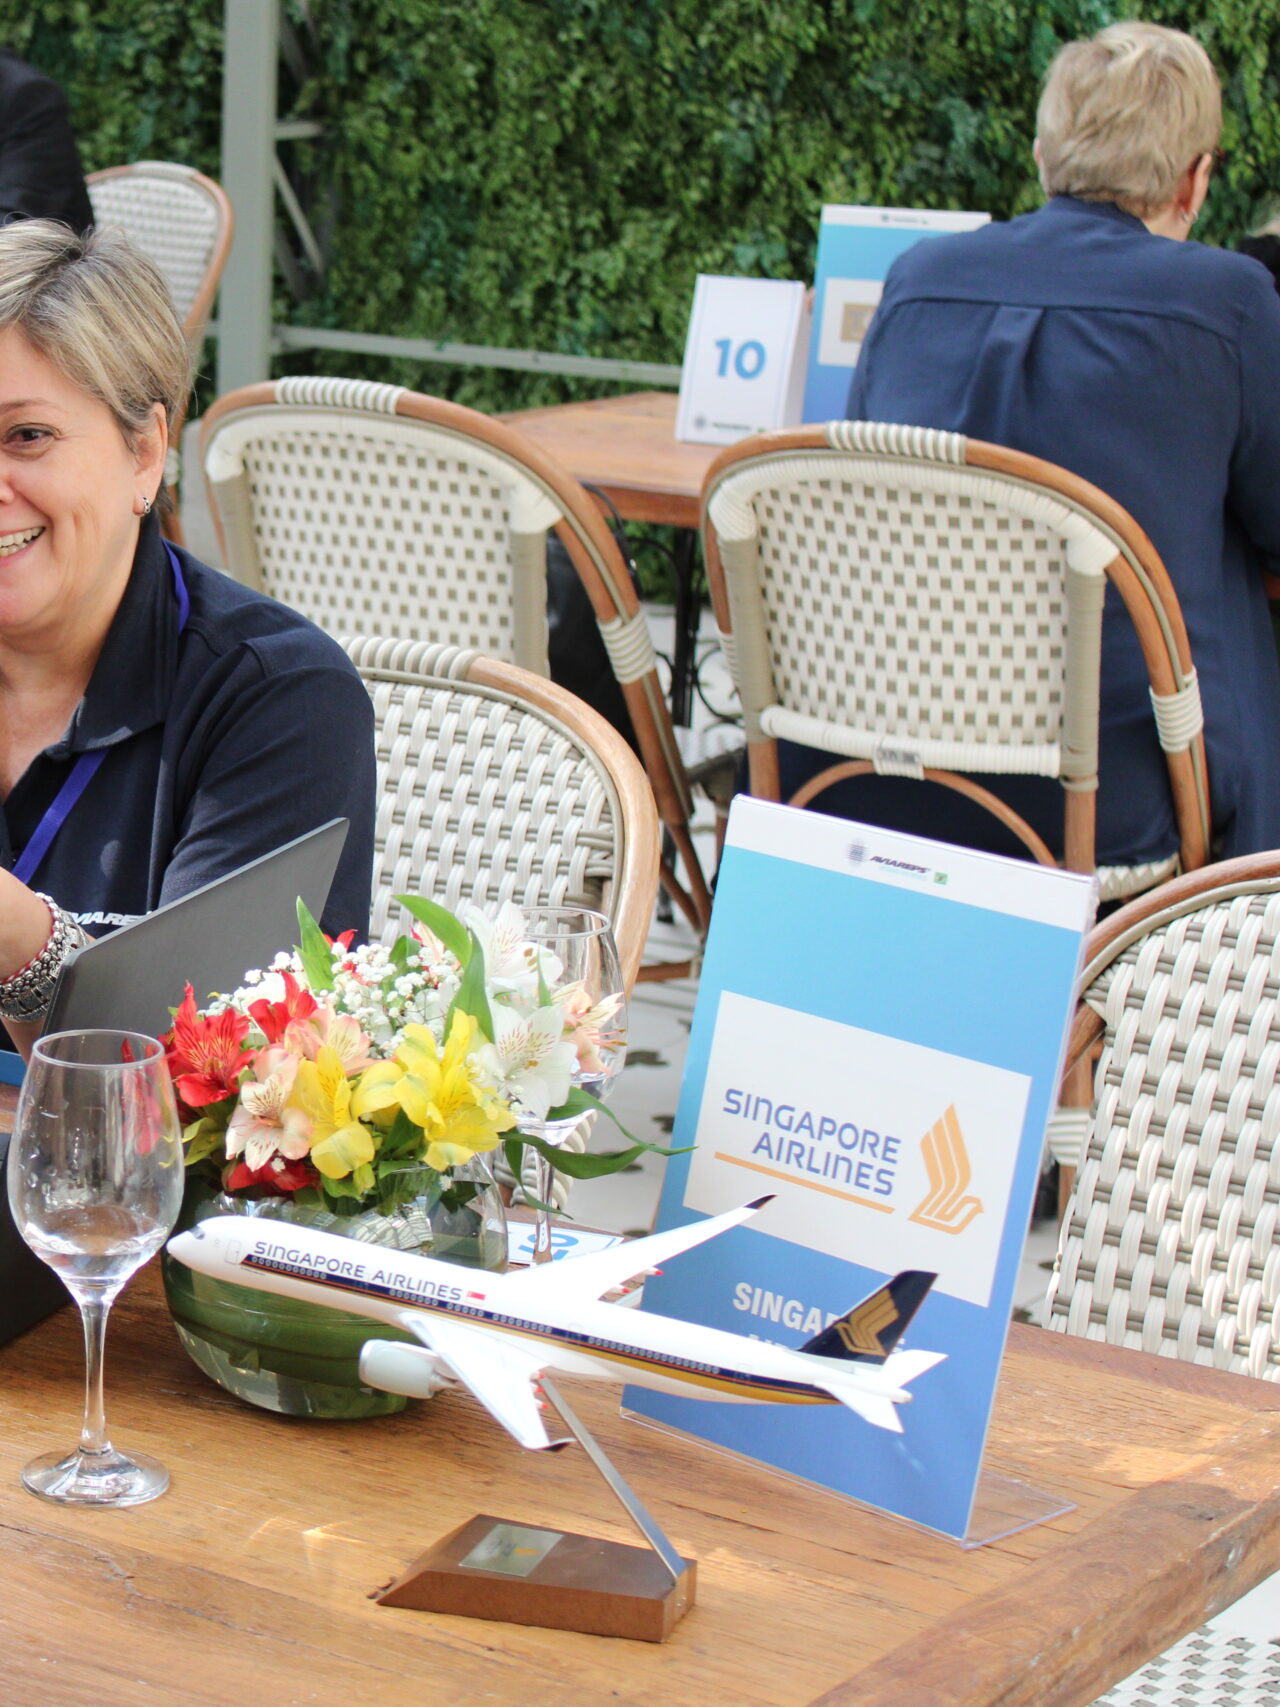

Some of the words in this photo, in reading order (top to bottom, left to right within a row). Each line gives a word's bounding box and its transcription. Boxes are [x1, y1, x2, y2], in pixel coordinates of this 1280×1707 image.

[715, 338, 767, 380] 10
[723, 1088, 902, 1165] SINGAPORE
[751, 1132, 896, 1196] AIRLINES
[254, 1241, 367, 1278] SINGAPORE
[371, 1269, 463, 1301] AIRLINES
